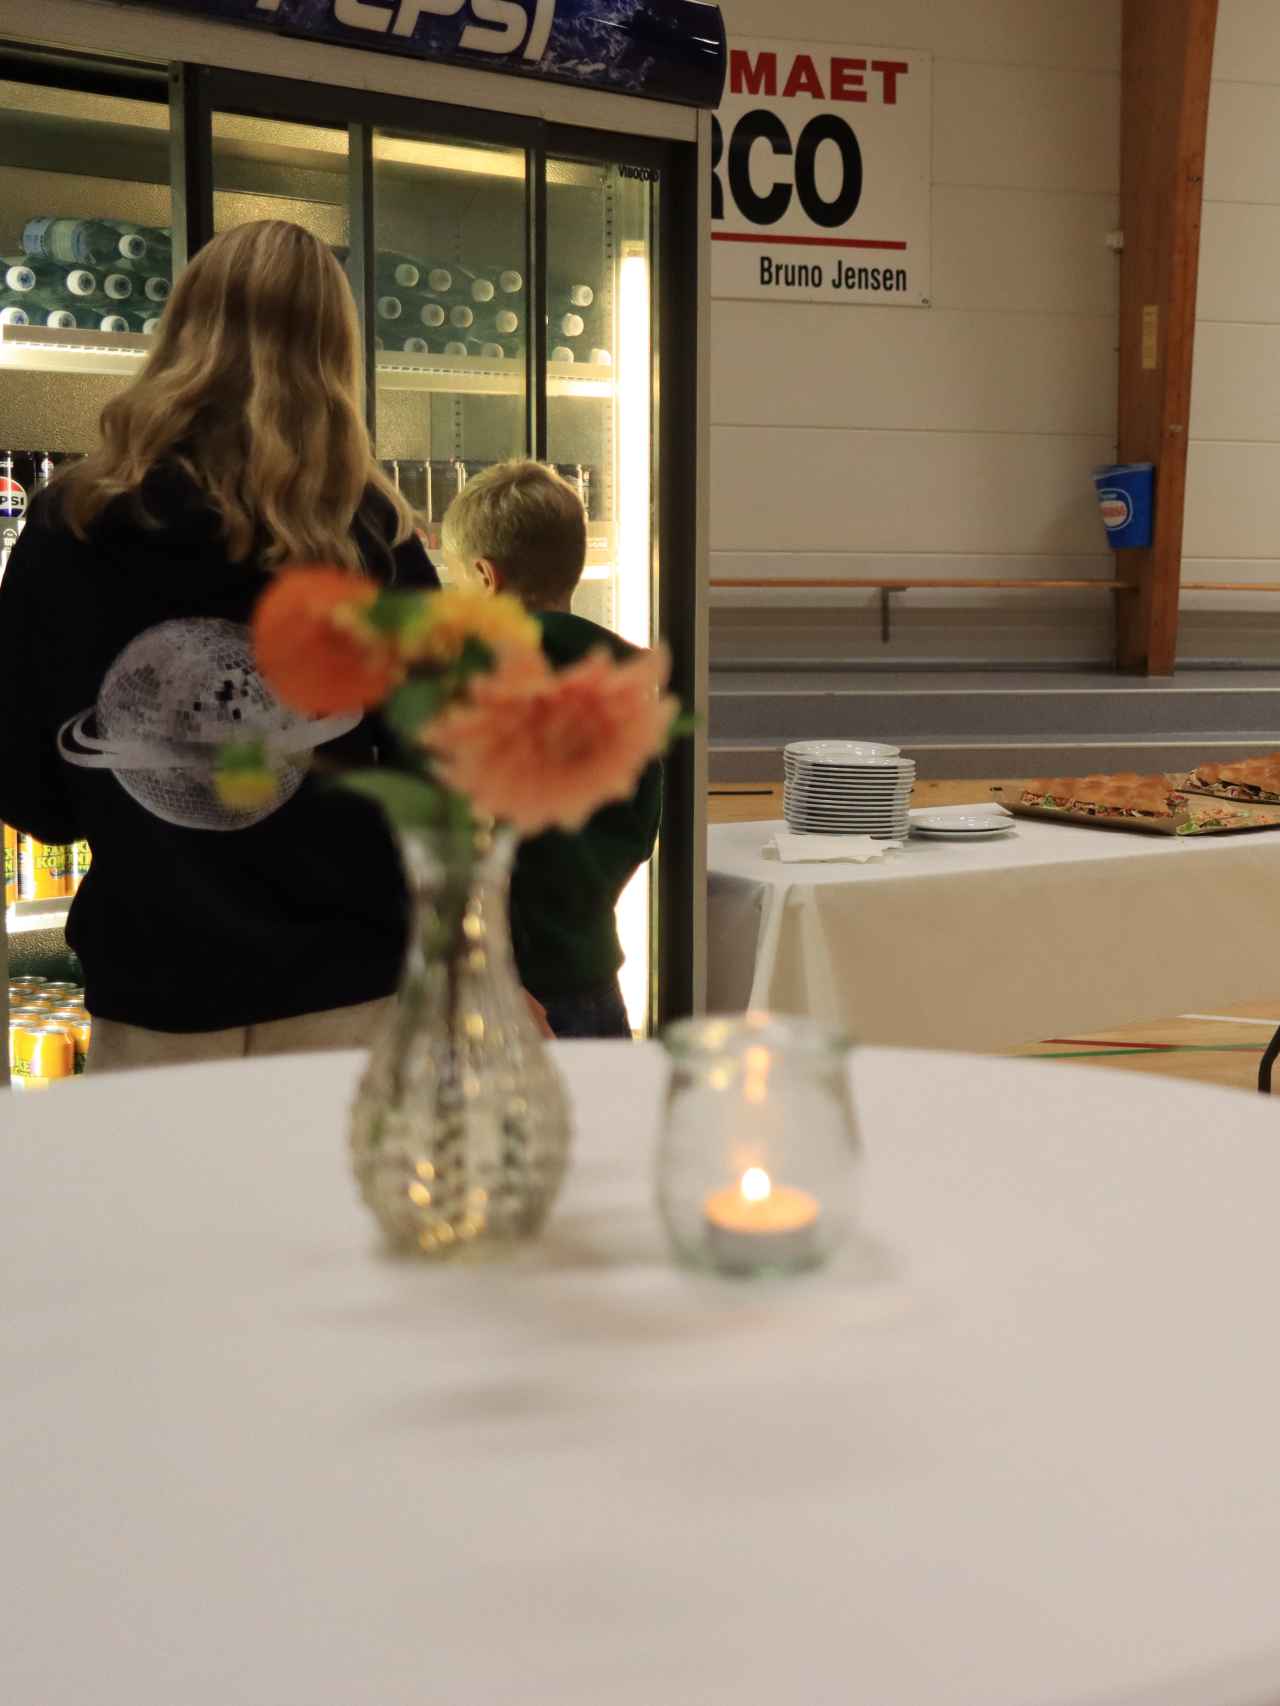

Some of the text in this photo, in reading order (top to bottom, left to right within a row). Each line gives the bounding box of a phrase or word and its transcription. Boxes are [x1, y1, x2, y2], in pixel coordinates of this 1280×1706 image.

[256, 0, 556, 61] EPSI
[712, 109, 862, 228] CO
[760, 257, 906, 291] Bruno Jensen
